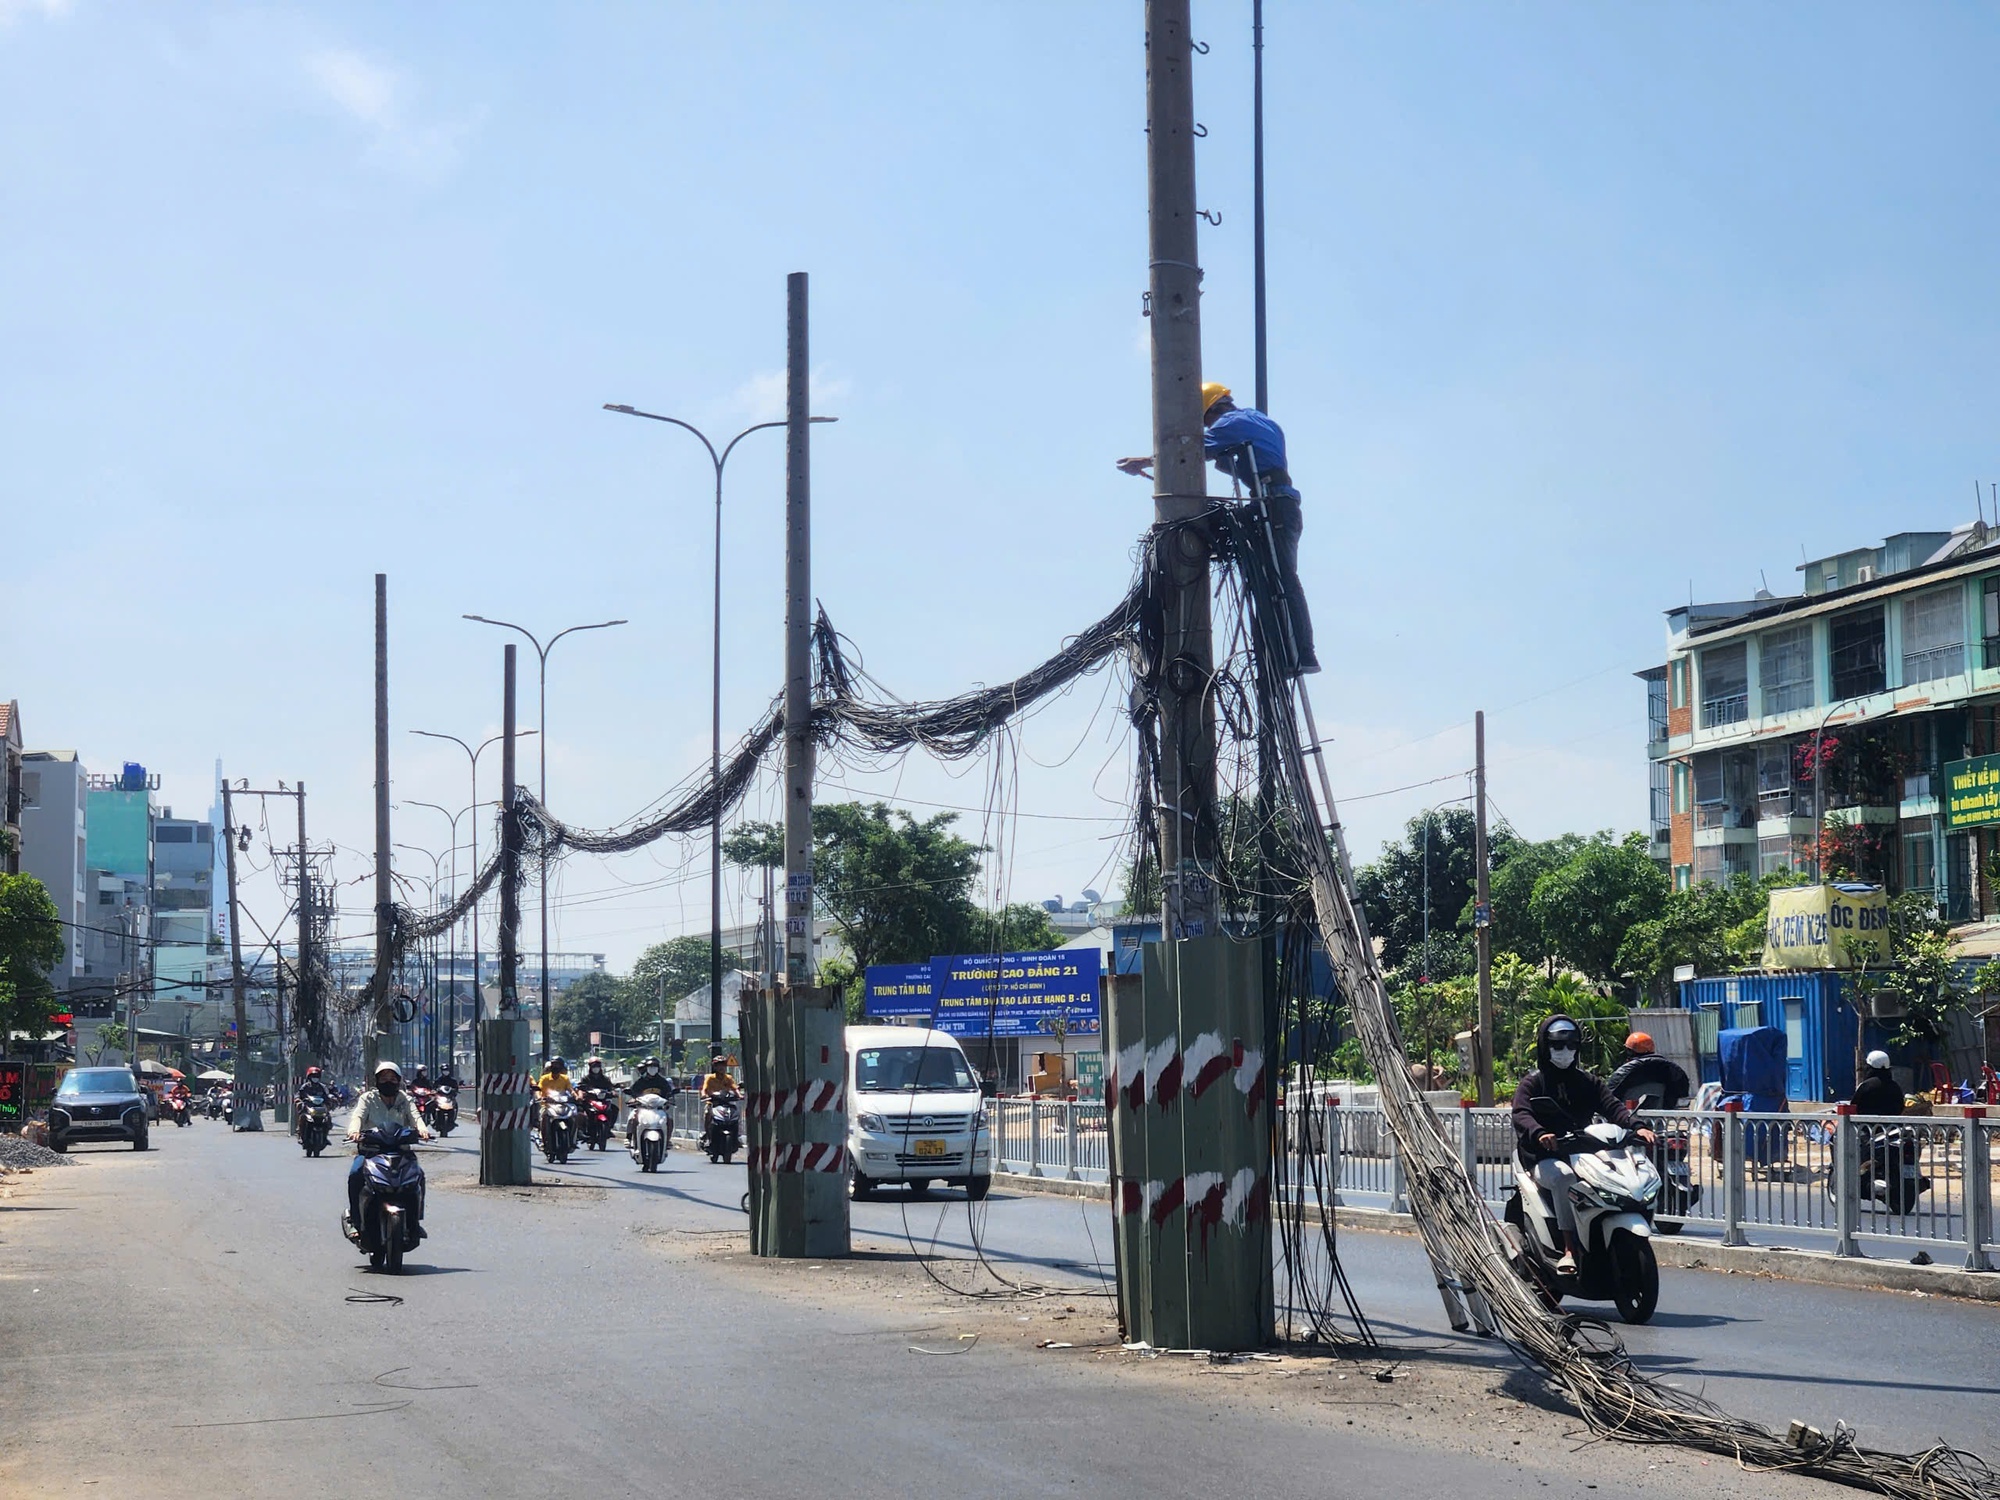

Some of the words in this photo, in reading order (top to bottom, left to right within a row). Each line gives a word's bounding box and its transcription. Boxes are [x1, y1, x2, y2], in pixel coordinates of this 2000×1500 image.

[1953, 764, 1976, 790] THIẾT
[1977, 761, 1989, 786] KẾ
[1990, 769, 1999, 784] IN
[1951, 797, 1960, 811] in
[1960, 793, 1984, 810] nhanh
[1830, 897, 1853, 929] ỐC
[963, 957, 972, 965] BỘ
[951, 967, 998, 981] TRƯỜNG
[1002, 968, 1024, 979] CAO
[1027, 963, 1060, 977] ĐẲNG
[1063, 966, 1078, 975] 21
[873, 986, 897, 996] TRUNG
[898, 983, 915, 995] TÂM
[940, 998, 964, 1007] TRUNG
[965, 995, 981, 1006] TÂM
[1000, 996, 1016, 1007] TẠO
[1017, 994, 1030, 1005] LÁI
[1032, 995, 1043, 1004] XE
[1044, 994, 1066, 1006] HẠNG
[1068, 993, 1074, 1002] B
[1080, 993, 1091, 1002] C1
[952, 1022, 965, 1031] TIN
[1086, 1064, 1099, 1073] IN
